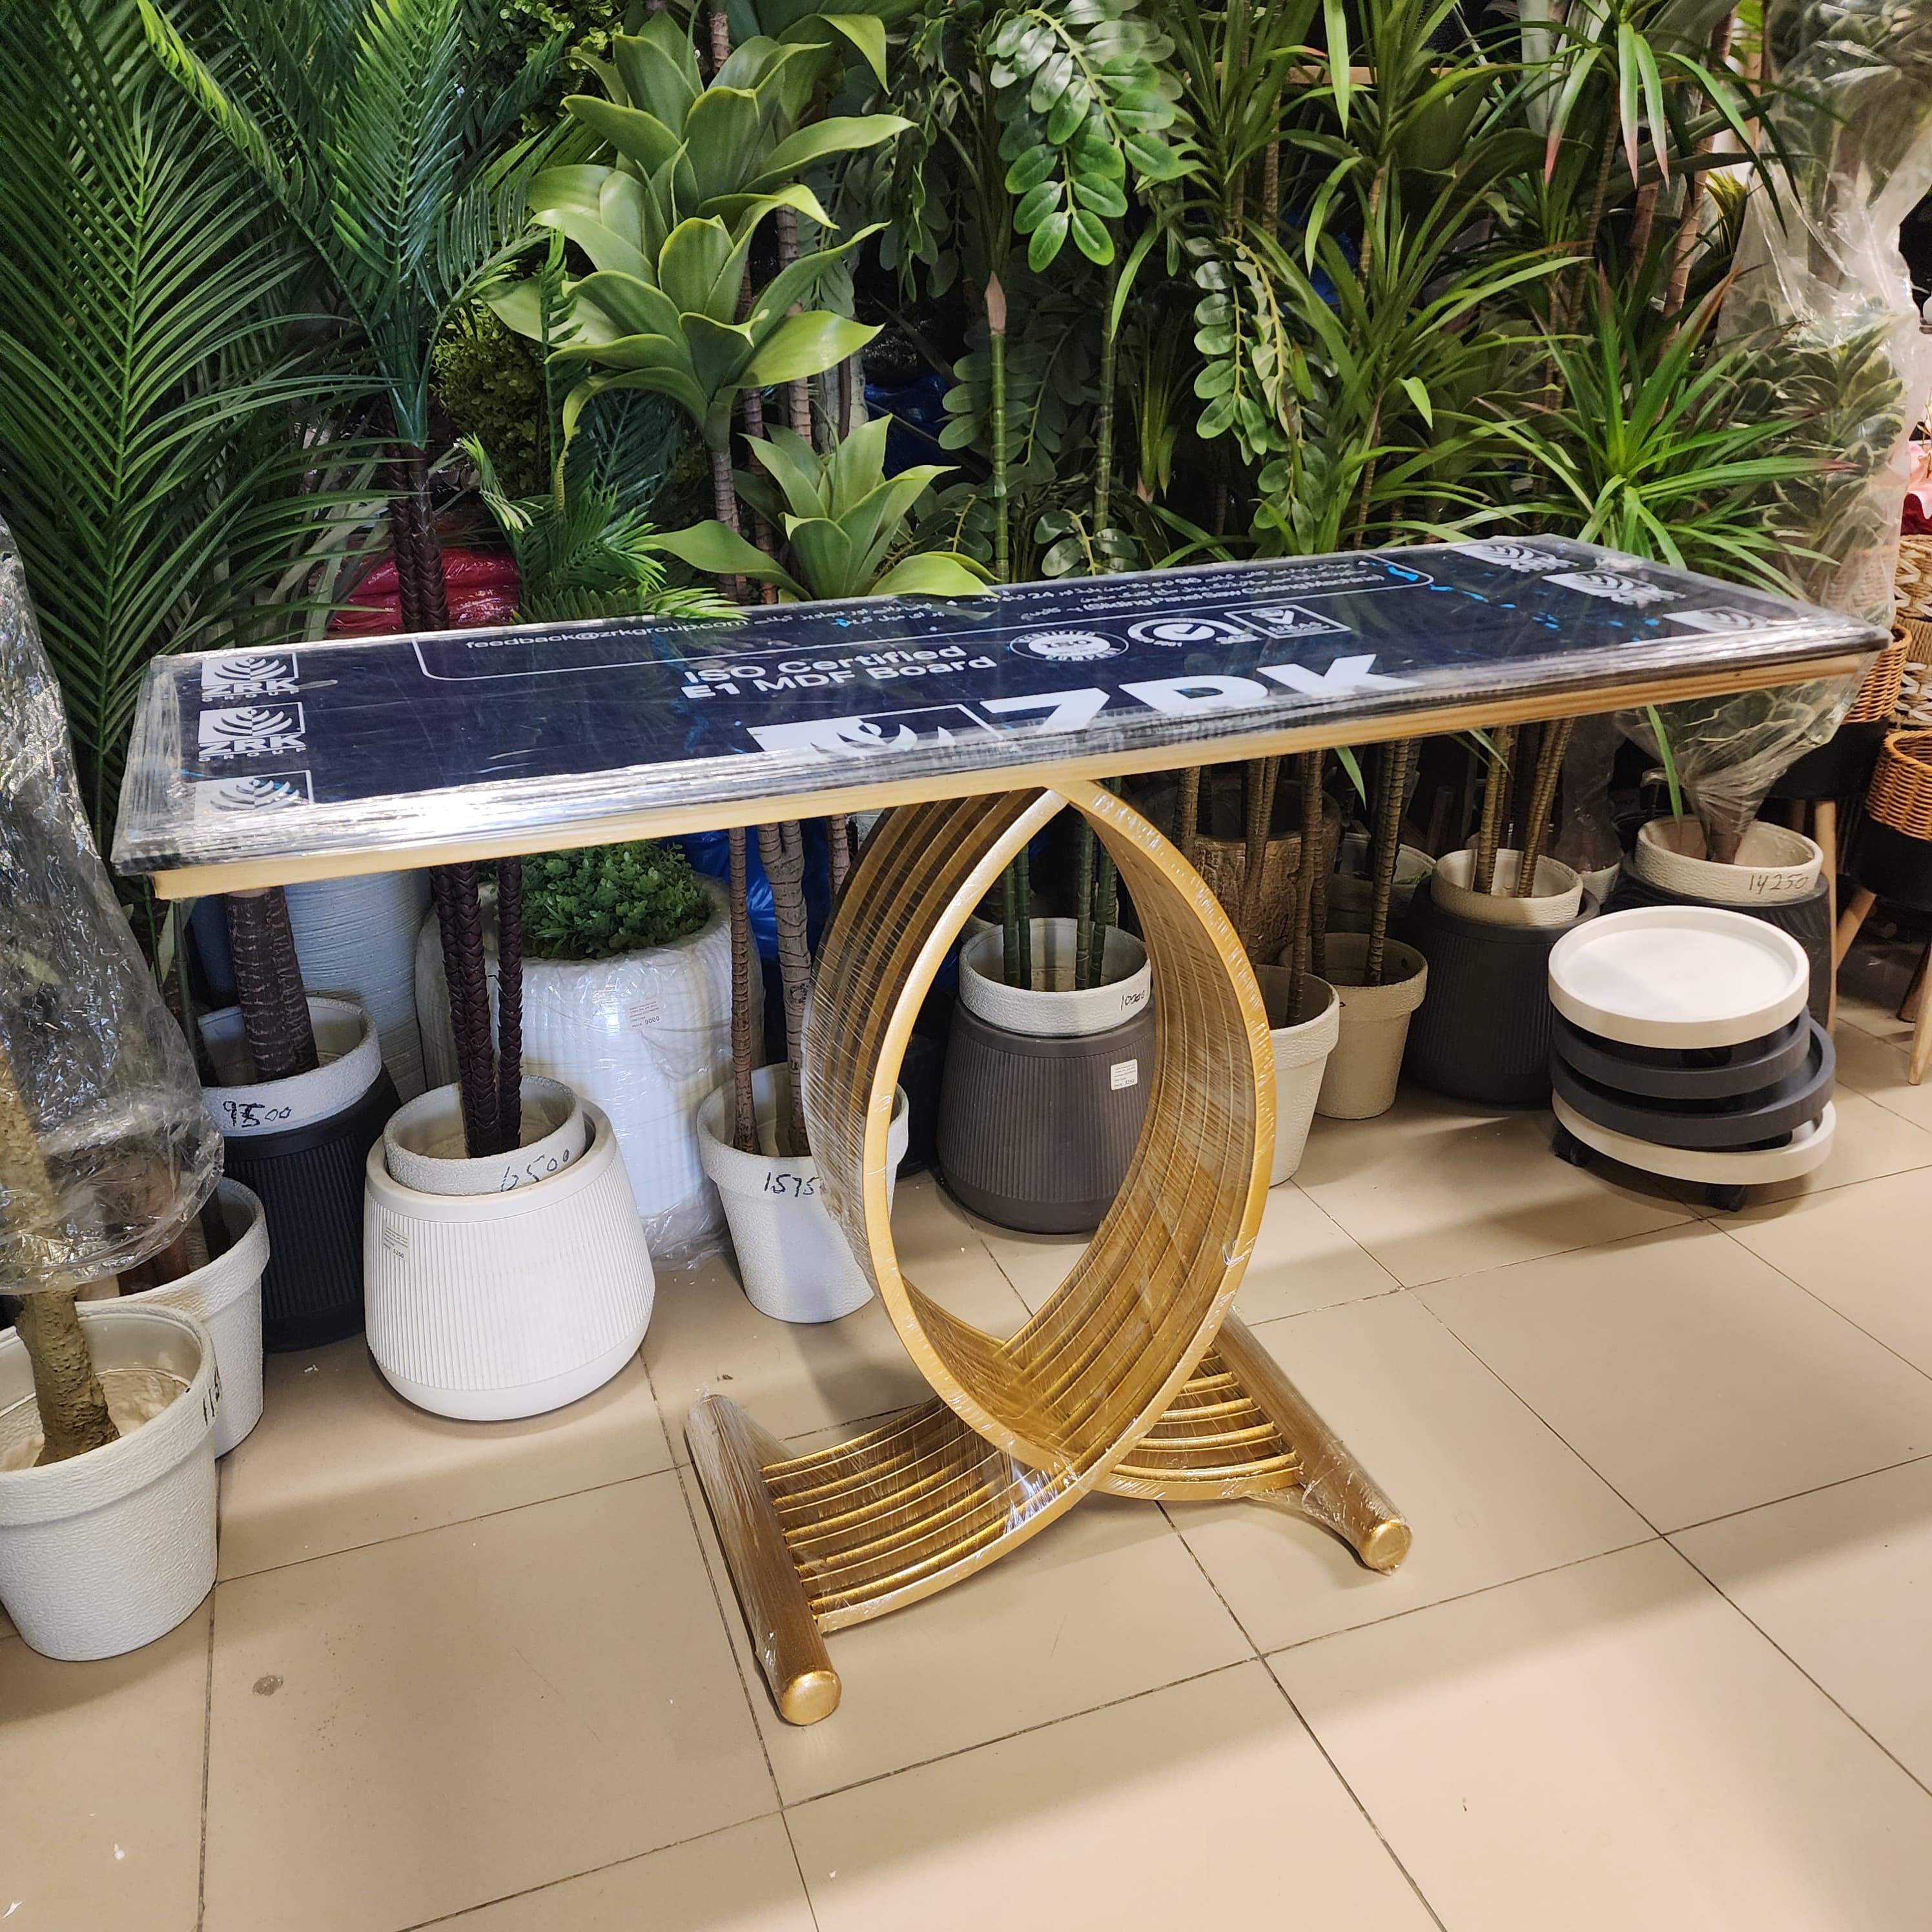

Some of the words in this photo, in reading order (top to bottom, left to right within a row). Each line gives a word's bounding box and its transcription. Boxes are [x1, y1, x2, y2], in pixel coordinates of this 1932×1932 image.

[465, 619, 749, 649] feedback@zrkgroup.com
[684, 665, 766, 683] ISO
[777, 646, 967, 673] Certified
[201, 678, 300, 696] ZRK
[681, 682, 741, 699] E1
[752, 670, 856, 692] MDF
[865, 656, 998, 680] Board
[198, 734, 307, 755] ZRK
[1749, 874, 1810, 894] 14250
[644, 1016, 660, 1025] 9000
[764, 1172, 825, 1198] 1575
